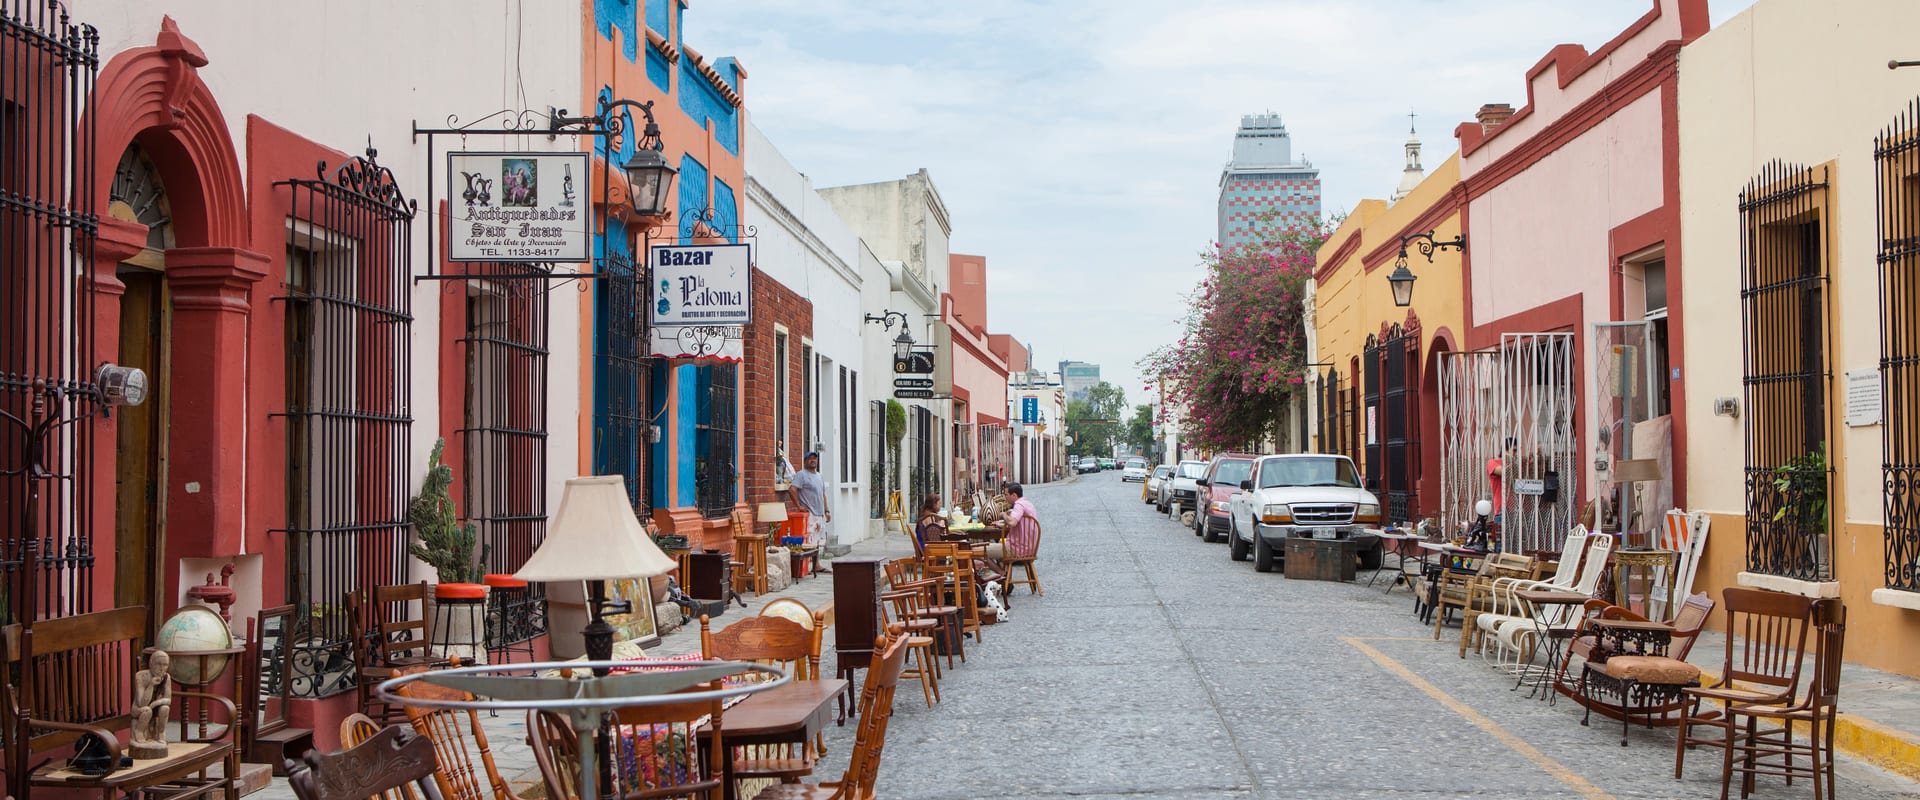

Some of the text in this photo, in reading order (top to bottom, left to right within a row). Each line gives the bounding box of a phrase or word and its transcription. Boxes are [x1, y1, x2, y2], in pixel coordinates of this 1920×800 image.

[465, 206, 576, 224] Antiguedades
[471, 222, 562, 238] San Juan
[465, 239, 492, 247] Objetos
[660, 249, 713, 266] Bazar
[698, 275, 704, 287] la
[678, 275, 741, 307] Paloma
